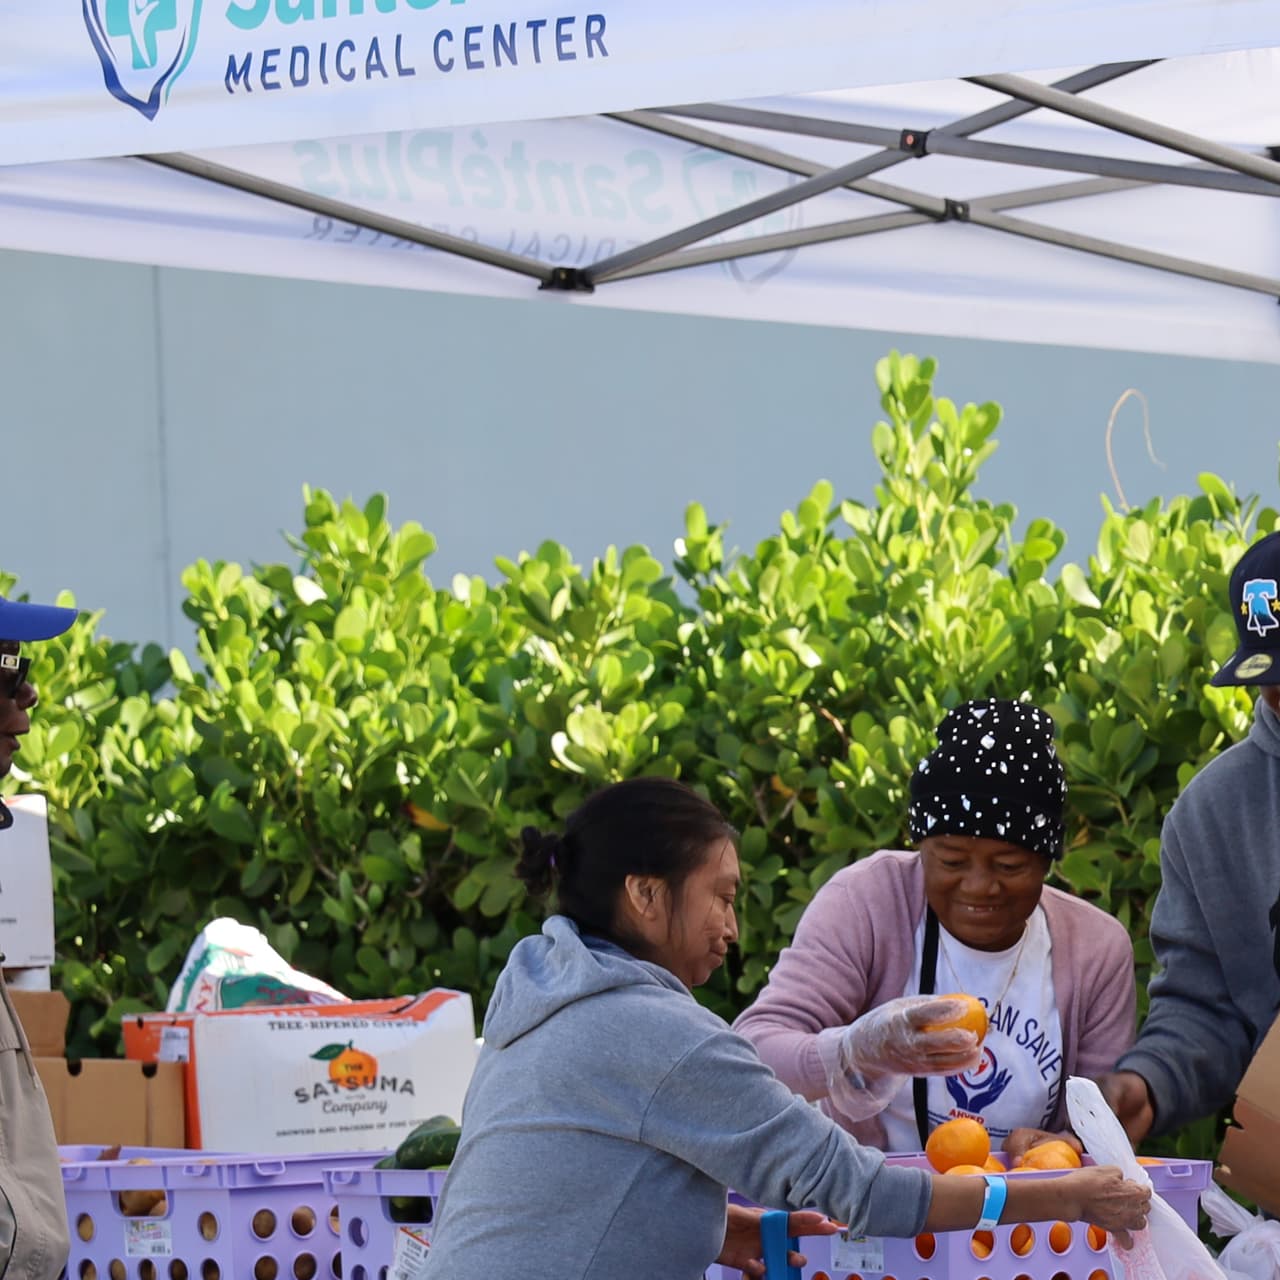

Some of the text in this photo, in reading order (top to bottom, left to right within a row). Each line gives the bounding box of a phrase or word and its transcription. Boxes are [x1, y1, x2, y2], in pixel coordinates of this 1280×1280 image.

[224, 33, 416, 94] MEDICAL
[433, 13, 609, 72] CENTER
[1016, 1017, 1063, 1081] SAVE
[294, 1075, 416, 1104] SATSUMA
[322, 1099, 388, 1117] Company
